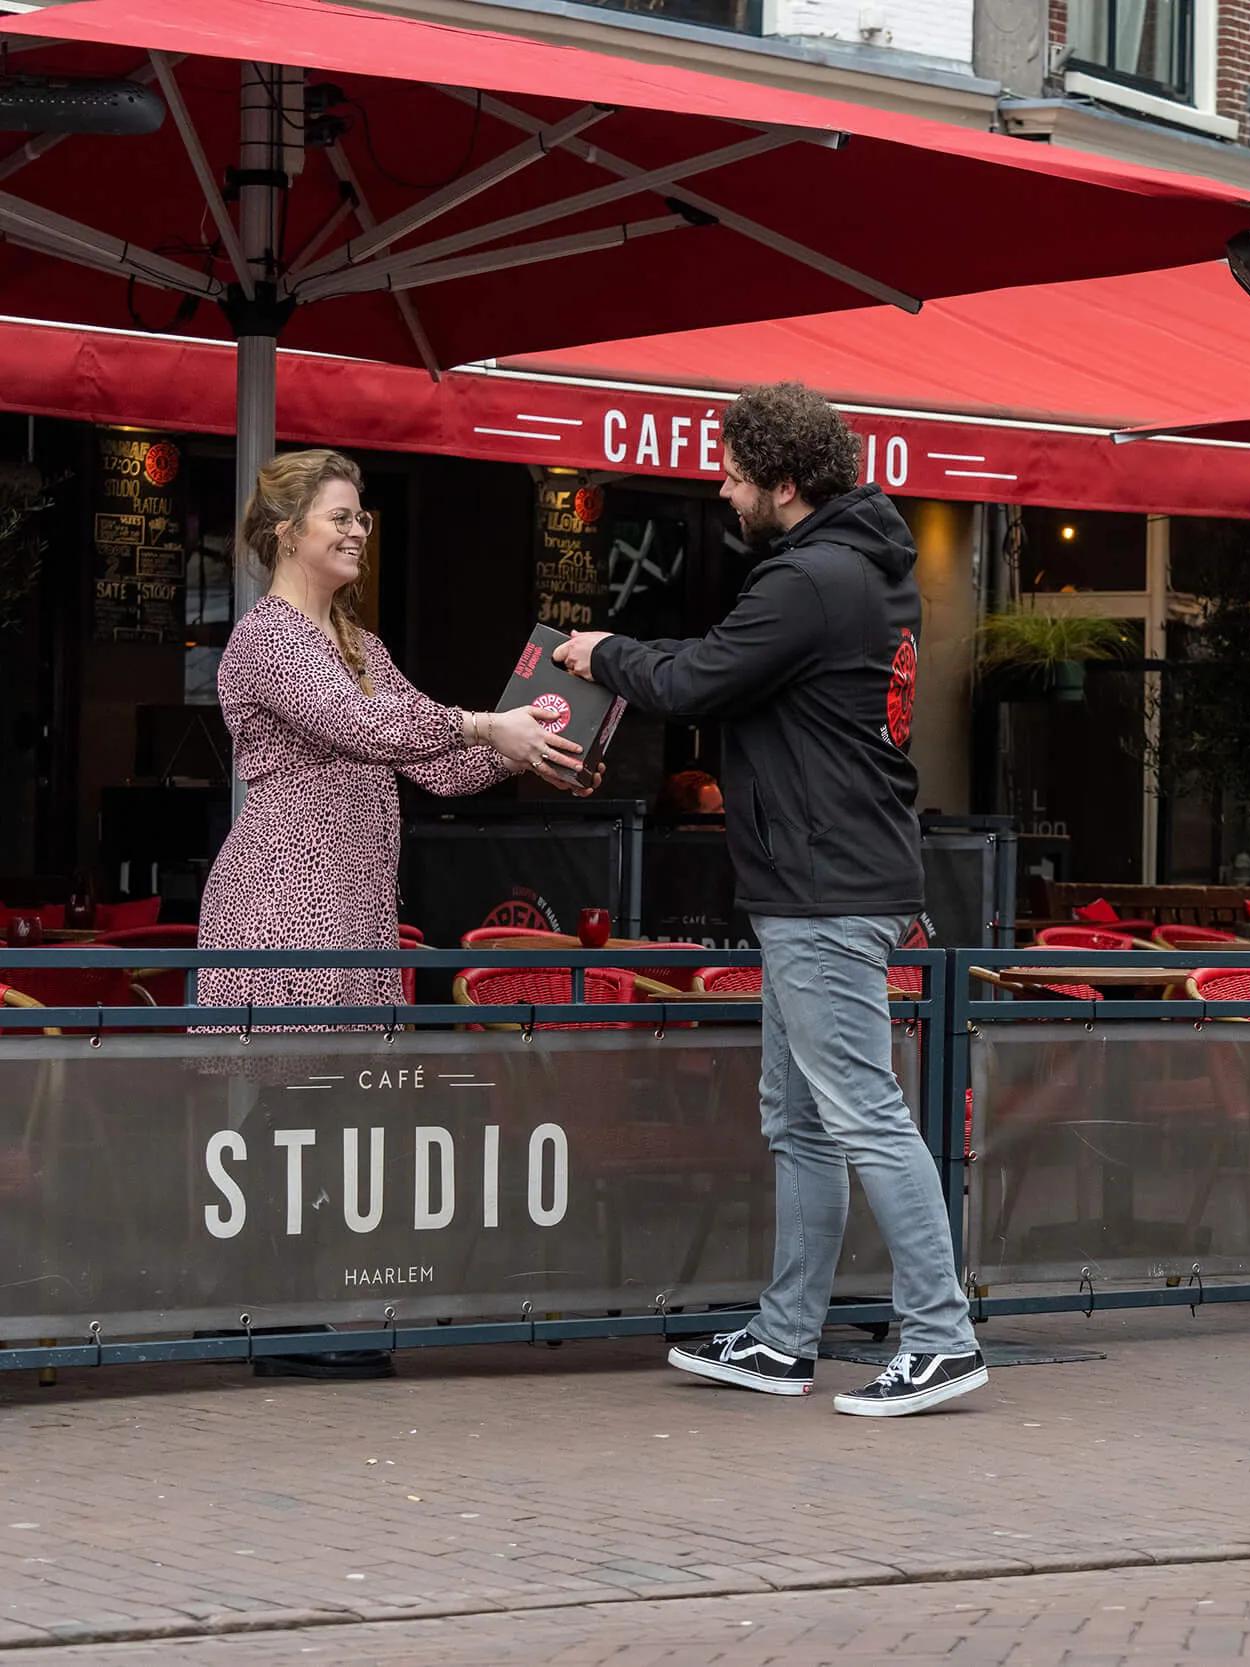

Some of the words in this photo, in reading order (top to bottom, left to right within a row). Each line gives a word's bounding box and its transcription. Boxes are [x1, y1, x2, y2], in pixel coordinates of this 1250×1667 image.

[604, 409, 721, 471] CAFÉ
[104, 456, 141, 476] 17:00
[104, 479, 141, 497] STUDIO
[132, 497, 172, 514] PLATEAU
[358, 1064, 426, 1090] CAFÉ
[204, 1122, 570, 1240] STUDIO
[344, 1265, 434, 1287] HAARLEM
